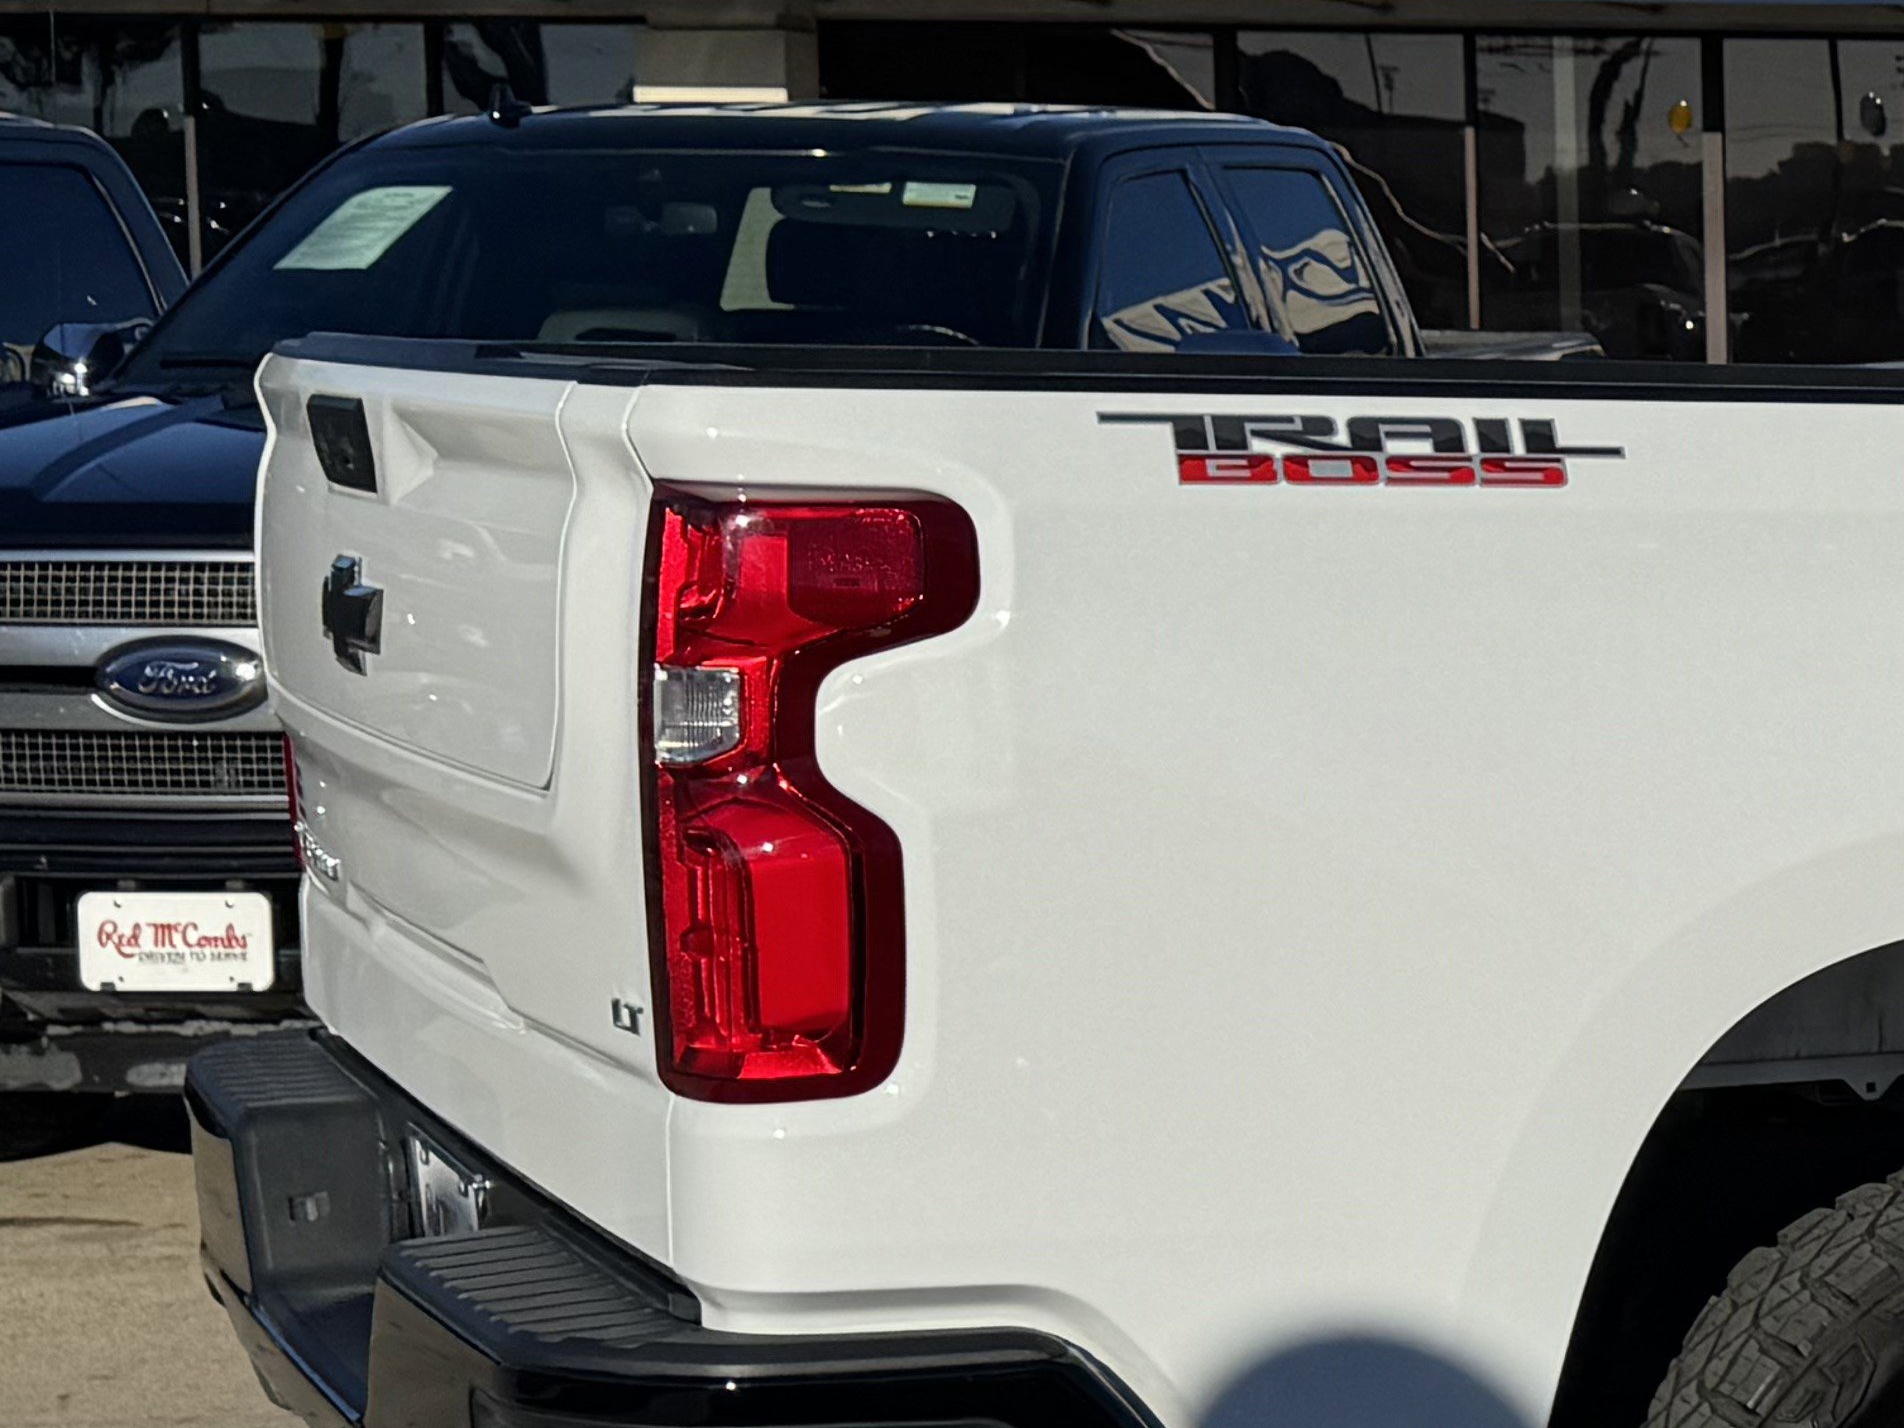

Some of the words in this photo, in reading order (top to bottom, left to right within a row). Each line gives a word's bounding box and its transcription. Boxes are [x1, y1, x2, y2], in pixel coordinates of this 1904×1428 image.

[1096, 410, 1626, 459] TRAIL
[1177, 453, 1569, 488] BOSS
[136, 659, 218, 695] Ford
[97, 919, 144, 959] Red
[611, 997, 644, 1038] LT
